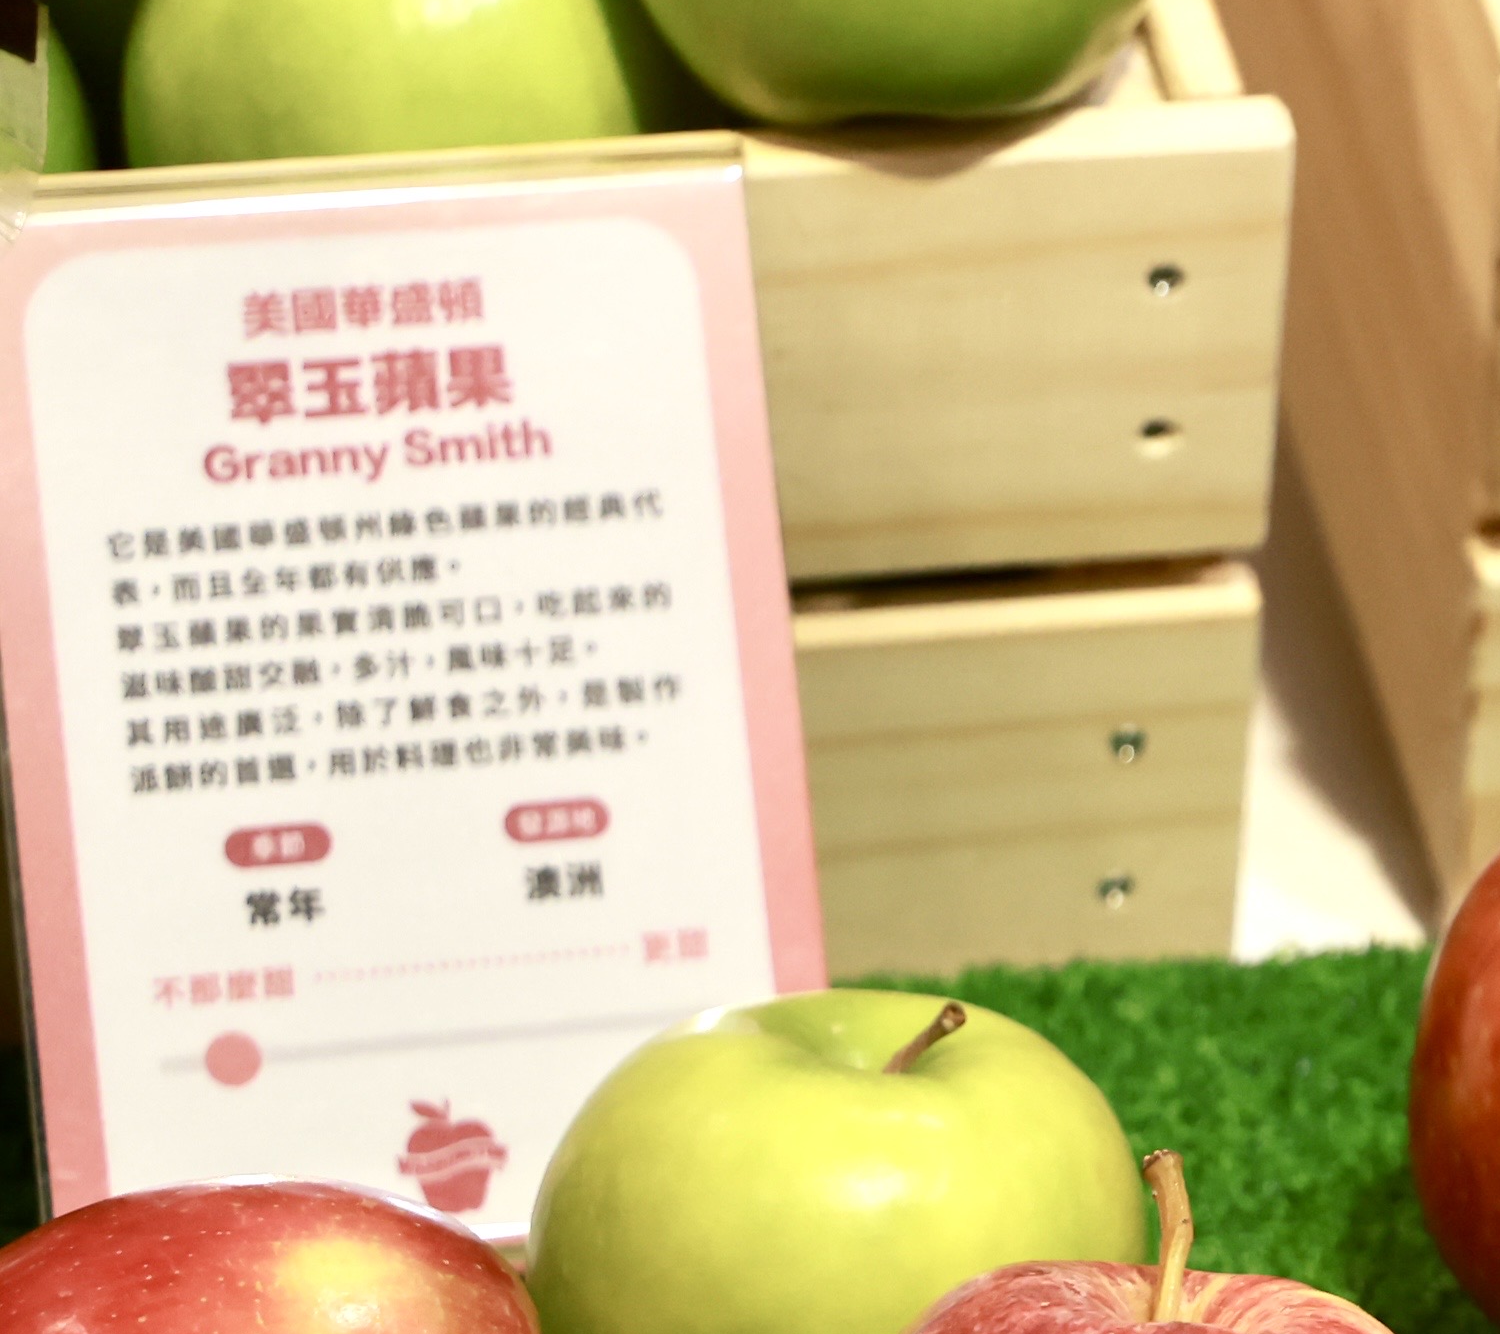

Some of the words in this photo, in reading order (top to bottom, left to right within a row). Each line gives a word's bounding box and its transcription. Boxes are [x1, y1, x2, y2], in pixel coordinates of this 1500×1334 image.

[245, 280, 482, 338] 美國華盛頓
[227, 346, 512, 425] 翠玉蘋果
[203, 437, 388, 484] Granny
[404, 420, 551, 466] Smith
[245, 888, 323, 927] 常年
[527, 865, 602, 901] 澳洲
